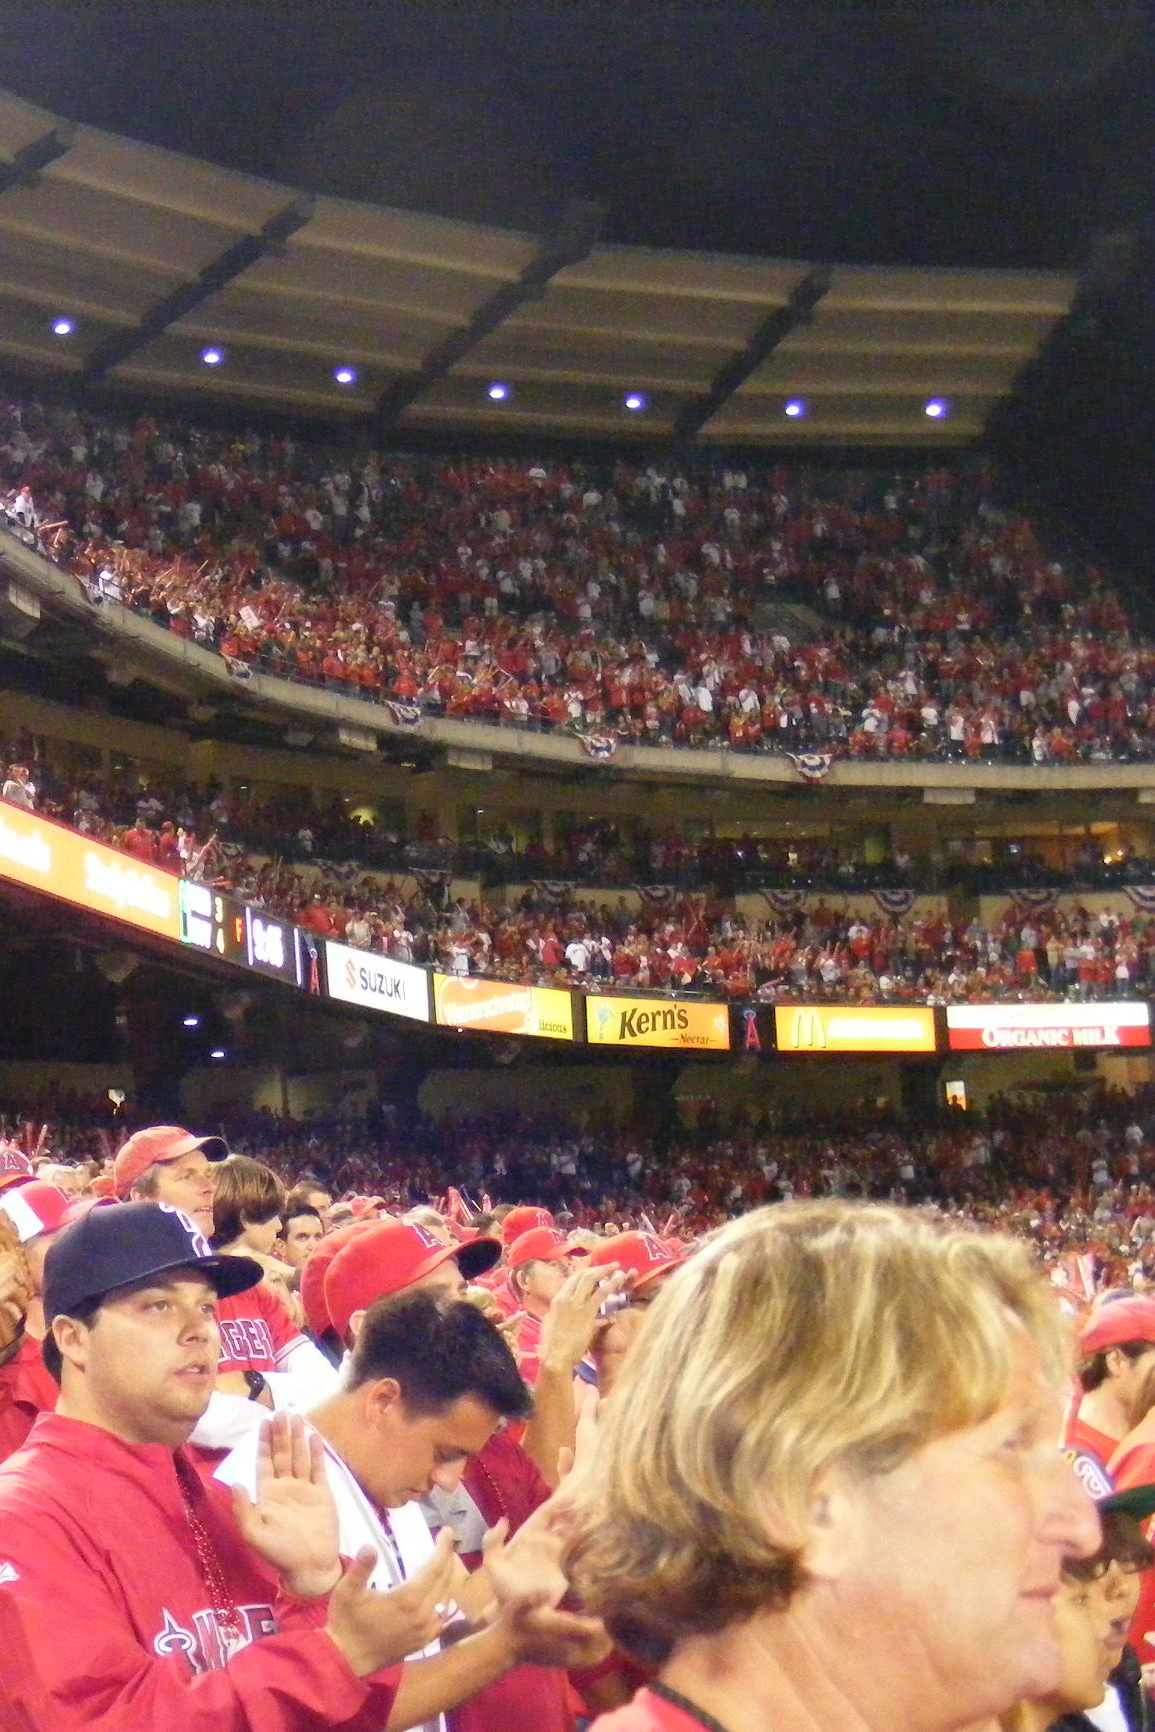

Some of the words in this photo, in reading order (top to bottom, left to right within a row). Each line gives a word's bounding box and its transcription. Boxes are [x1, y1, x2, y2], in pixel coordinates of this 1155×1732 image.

[214, 897, 224, 923] 3
[234, 917, 243, 943] F
[358, 966, 406, 1001] SUZUKI
[618, 1003, 689, 1041] Kern's
[981, 1027, 1069, 1048] ORGANIC
[1072, 1024, 1121, 1046] MILK
